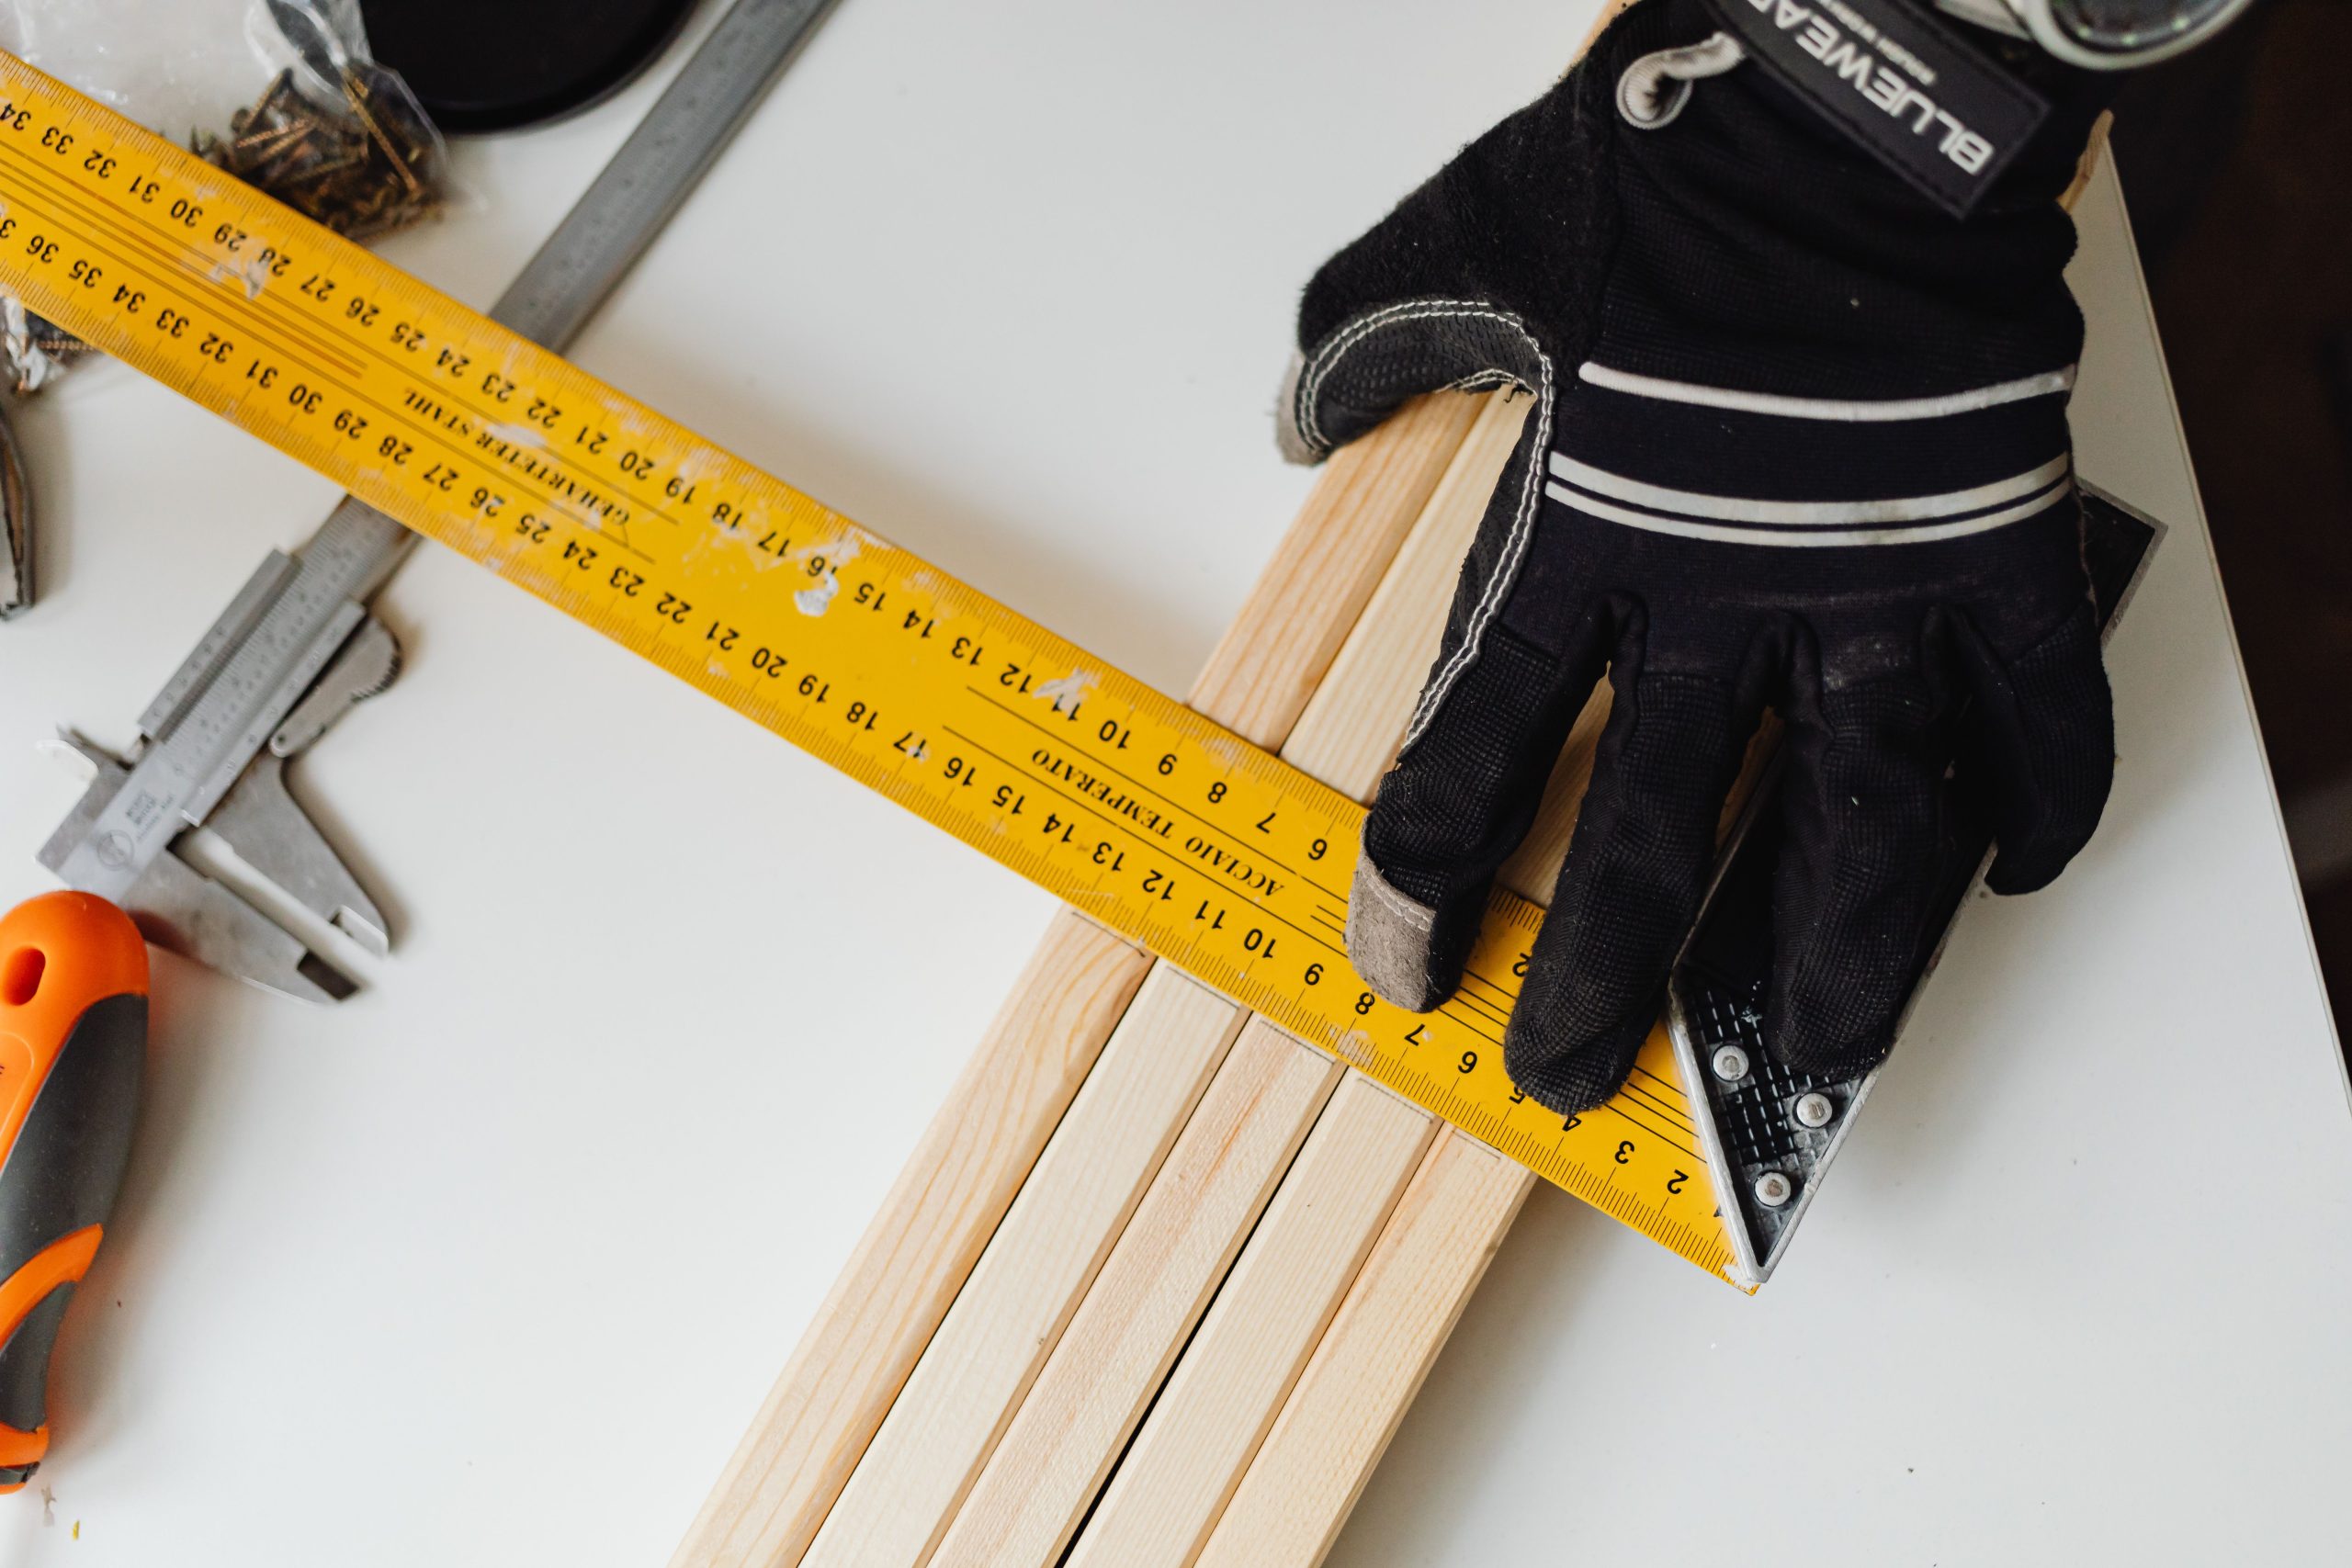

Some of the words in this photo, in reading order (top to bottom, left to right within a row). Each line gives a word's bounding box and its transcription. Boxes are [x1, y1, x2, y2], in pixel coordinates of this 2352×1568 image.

[0, 103, 31, 131] 34
[40, 127, 74, 155] 33
[84, 150, 117, 178] 32
[129, 175, 160, 203] 31
[170, 199, 203, 227] 30
[0, 219, 17, 239] 3
[214, 224, 247, 251] 29
[26, 235, 60, 264] 36
[68, 260, 103, 288] 35
[112, 284, 146, 313] 34
[300, 276, 335, 301] 27
[155, 309, 189, 338] 33
[346, 298, 379, 326] 26
[199, 333, 233, 363] 32
[392, 323, 425, 349] 25
[246, 360, 278, 389] 31
[436, 348, 470, 375] 24
[288, 384, 322, 413] 30
[481, 374, 515, 402] 23
[334, 411, 368, 439] 29
[404, 387, 475, 436] STAHL
[527, 400, 561, 427] 22
[379, 436, 413, 465] 28
[576, 426, 608, 454] 21
[423, 464, 458, 491] 27
[619, 451, 655, 480] 20
[470, 488, 504, 517] 26
[665, 478, 695, 504] 19
[516, 514, 551, 543] 25
[712, 502, 742, 530] 18
[563, 540, 598, 570] 24
[757, 531, 790, 558] 17
[609, 567, 645, 597] 23
[656, 592, 692, 624] 22
[854, 582, 886, 611] 15
[706, 621, 740, 651] 21
[903, 610, 934, 638] 14
[752, 647, 787, 678] 20
[951, 637, 983, 666] 13
[798, 674, 830, 703] 19
[1000, 663, 1032, 694] 12
[846, 701, 878, 730] 18
[1051, 694, 1080, 721] 11
[893, 731, 927, 759] 17
[1098, 719, 1131, 750] 10
[944, 756, 976, 786] 16
[1158, 753, 1178, 776] 9
[991, 784, 1025, 815] 15
[1031, 747, 1174, 840] TEMPERATO
[1207, 781, 1227, 804] 8
[1043, 813, 1075, 843] 14
[1255, 812, 1276, 834] 7
[1092, 841, 1125, 872] 13
[1307, 838, 1328, 861] 6
[1185, 835, 1285, 898] ACCIAIO
[1142, 869, 1175, 900] 12
[1194, 900, 1226, 930] 11
[1243, 928, 1276, 959] 10
[1304, 963, 1324, 987] 9
[1354, 991, 1375, 1016] 8
[1404, 1023, 1426, 1047] 7
[1457, 1050, 1478, 1075] 6
[1563, 1114, 1581, 1132] 4
[1614, 1140, 1635, 1165] 3
[1667, 1168, 1690, 1195] 2
